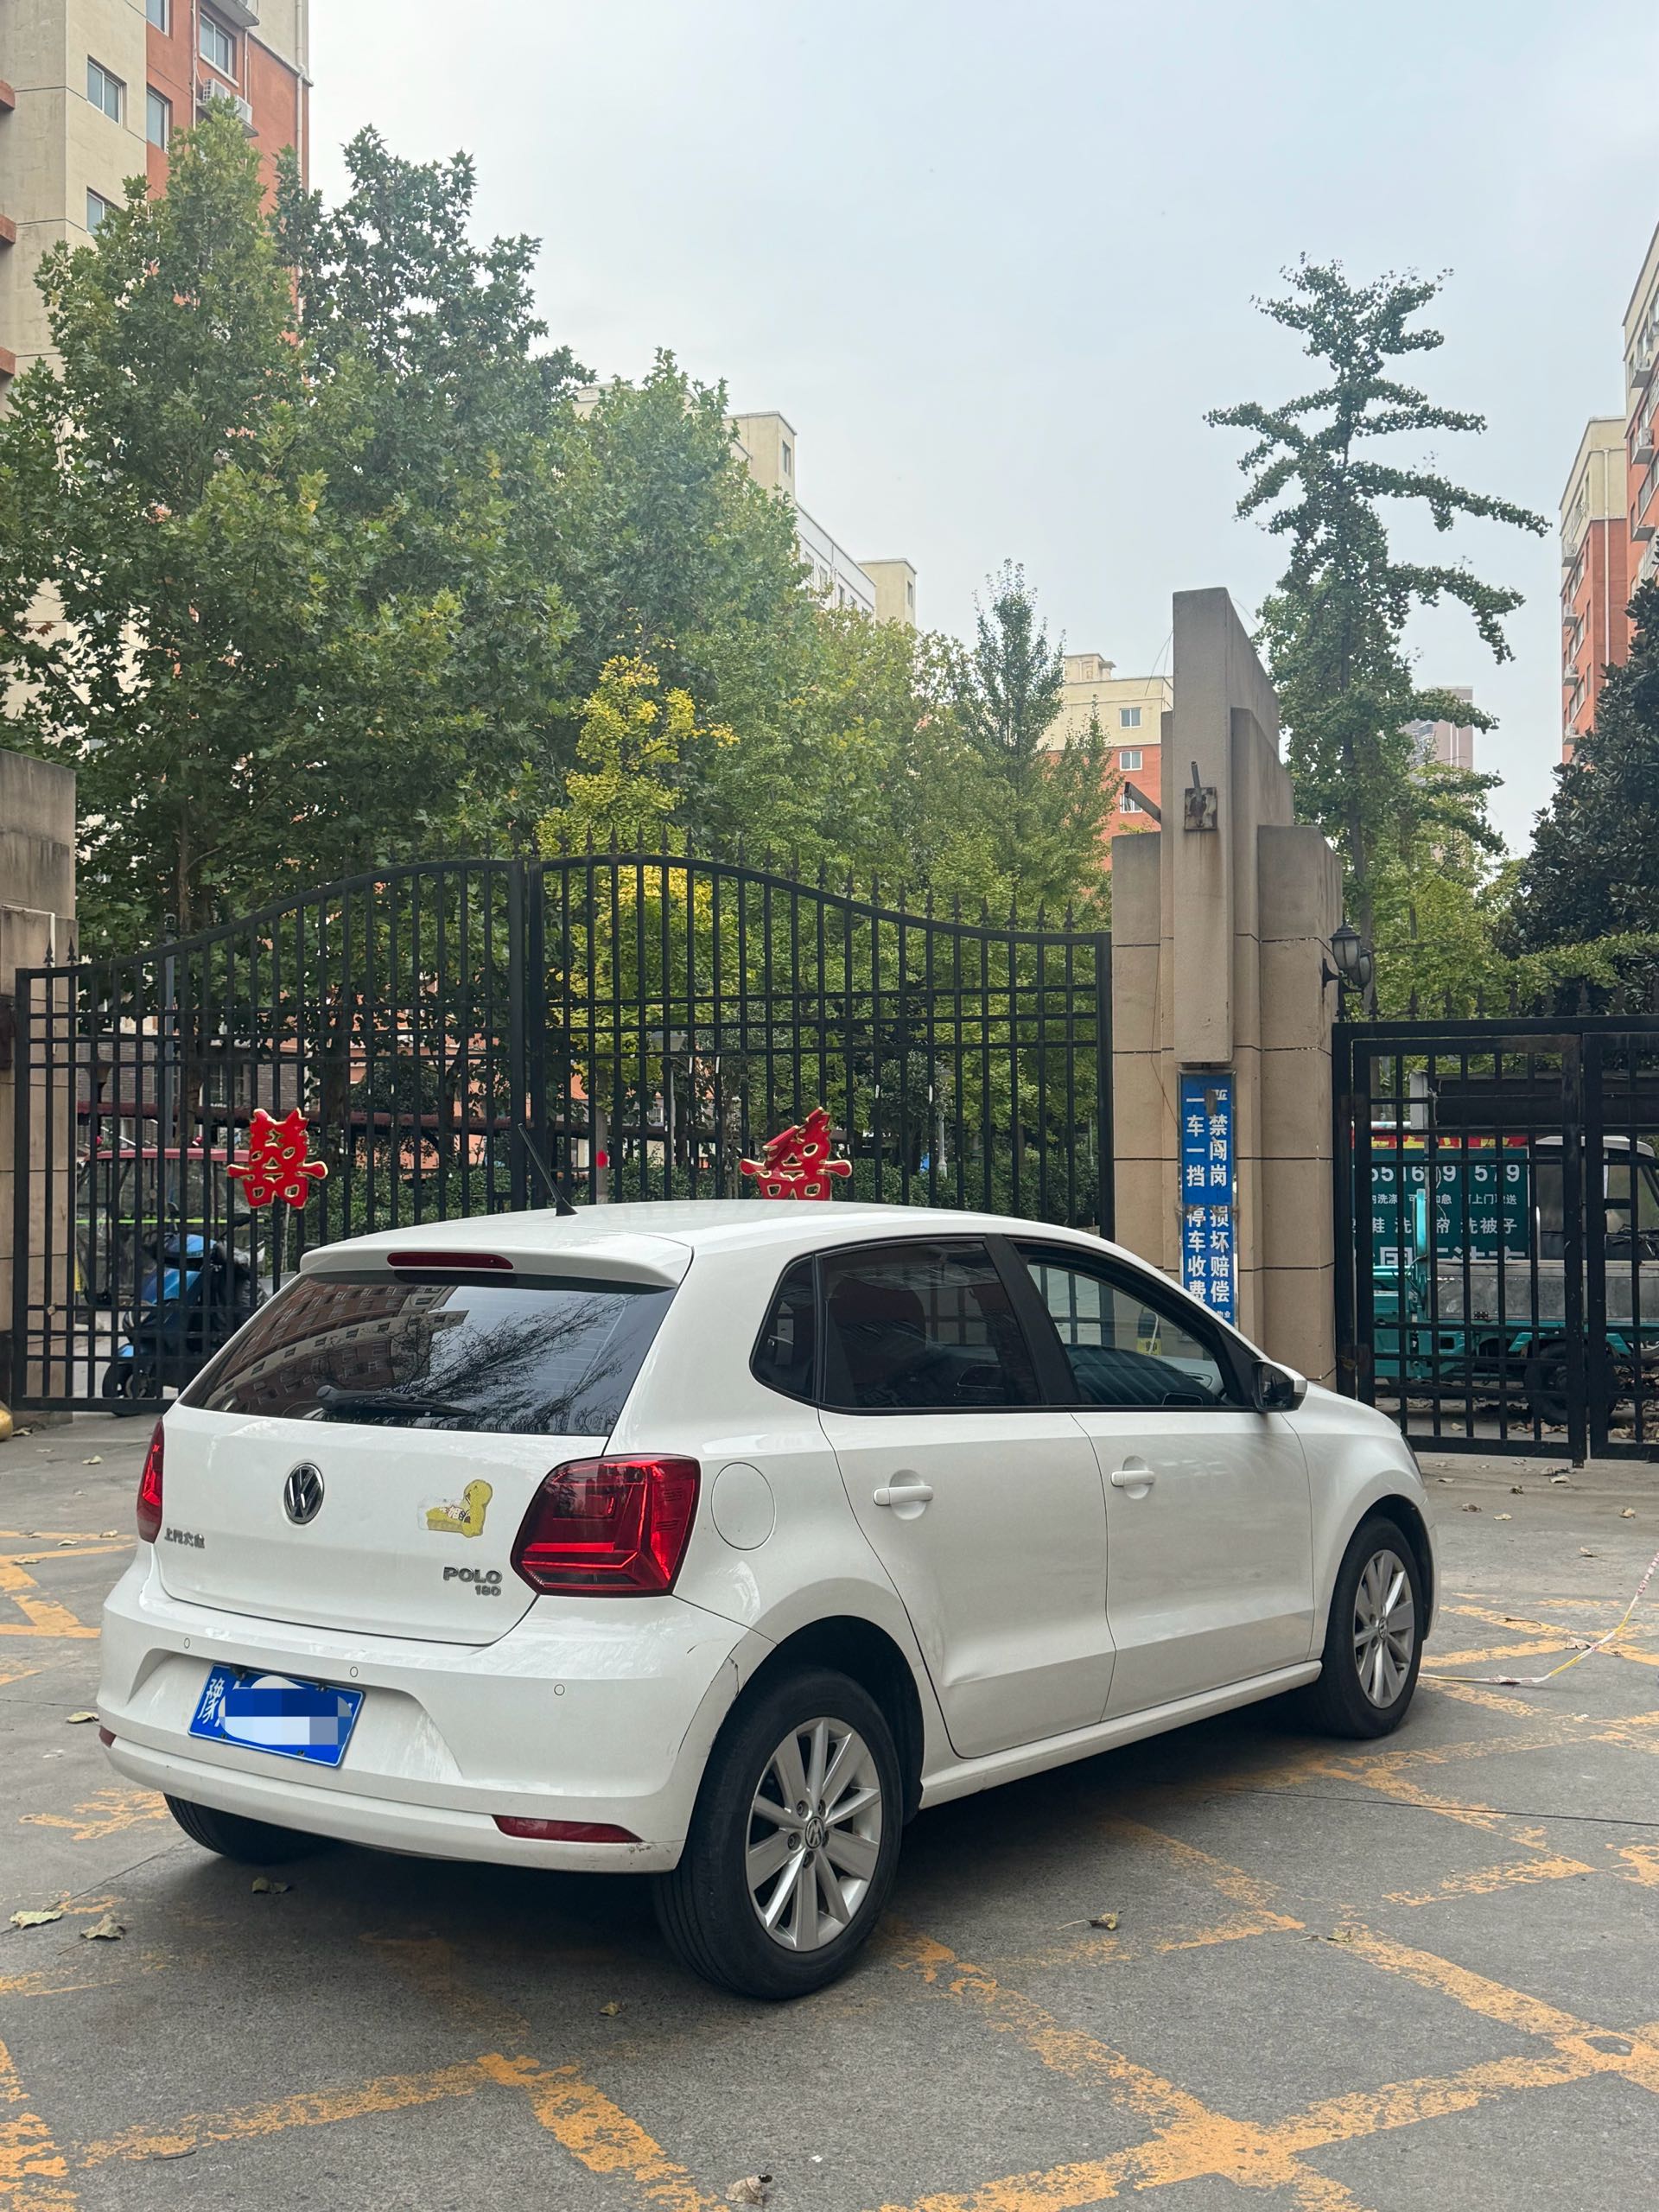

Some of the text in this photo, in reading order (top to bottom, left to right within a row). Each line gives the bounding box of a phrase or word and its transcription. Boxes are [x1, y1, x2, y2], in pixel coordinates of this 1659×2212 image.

[1186, 1098, 1205, 1187] 一车一挡
[1208, 1089, 1229, 1187] 严禁闯岗
[1186, 1206, 1207, 1302] 停车收费
[1210, 1205, 1230, 1304] 损坏赔偿
[442, 1566, 503, 1585] POLO
